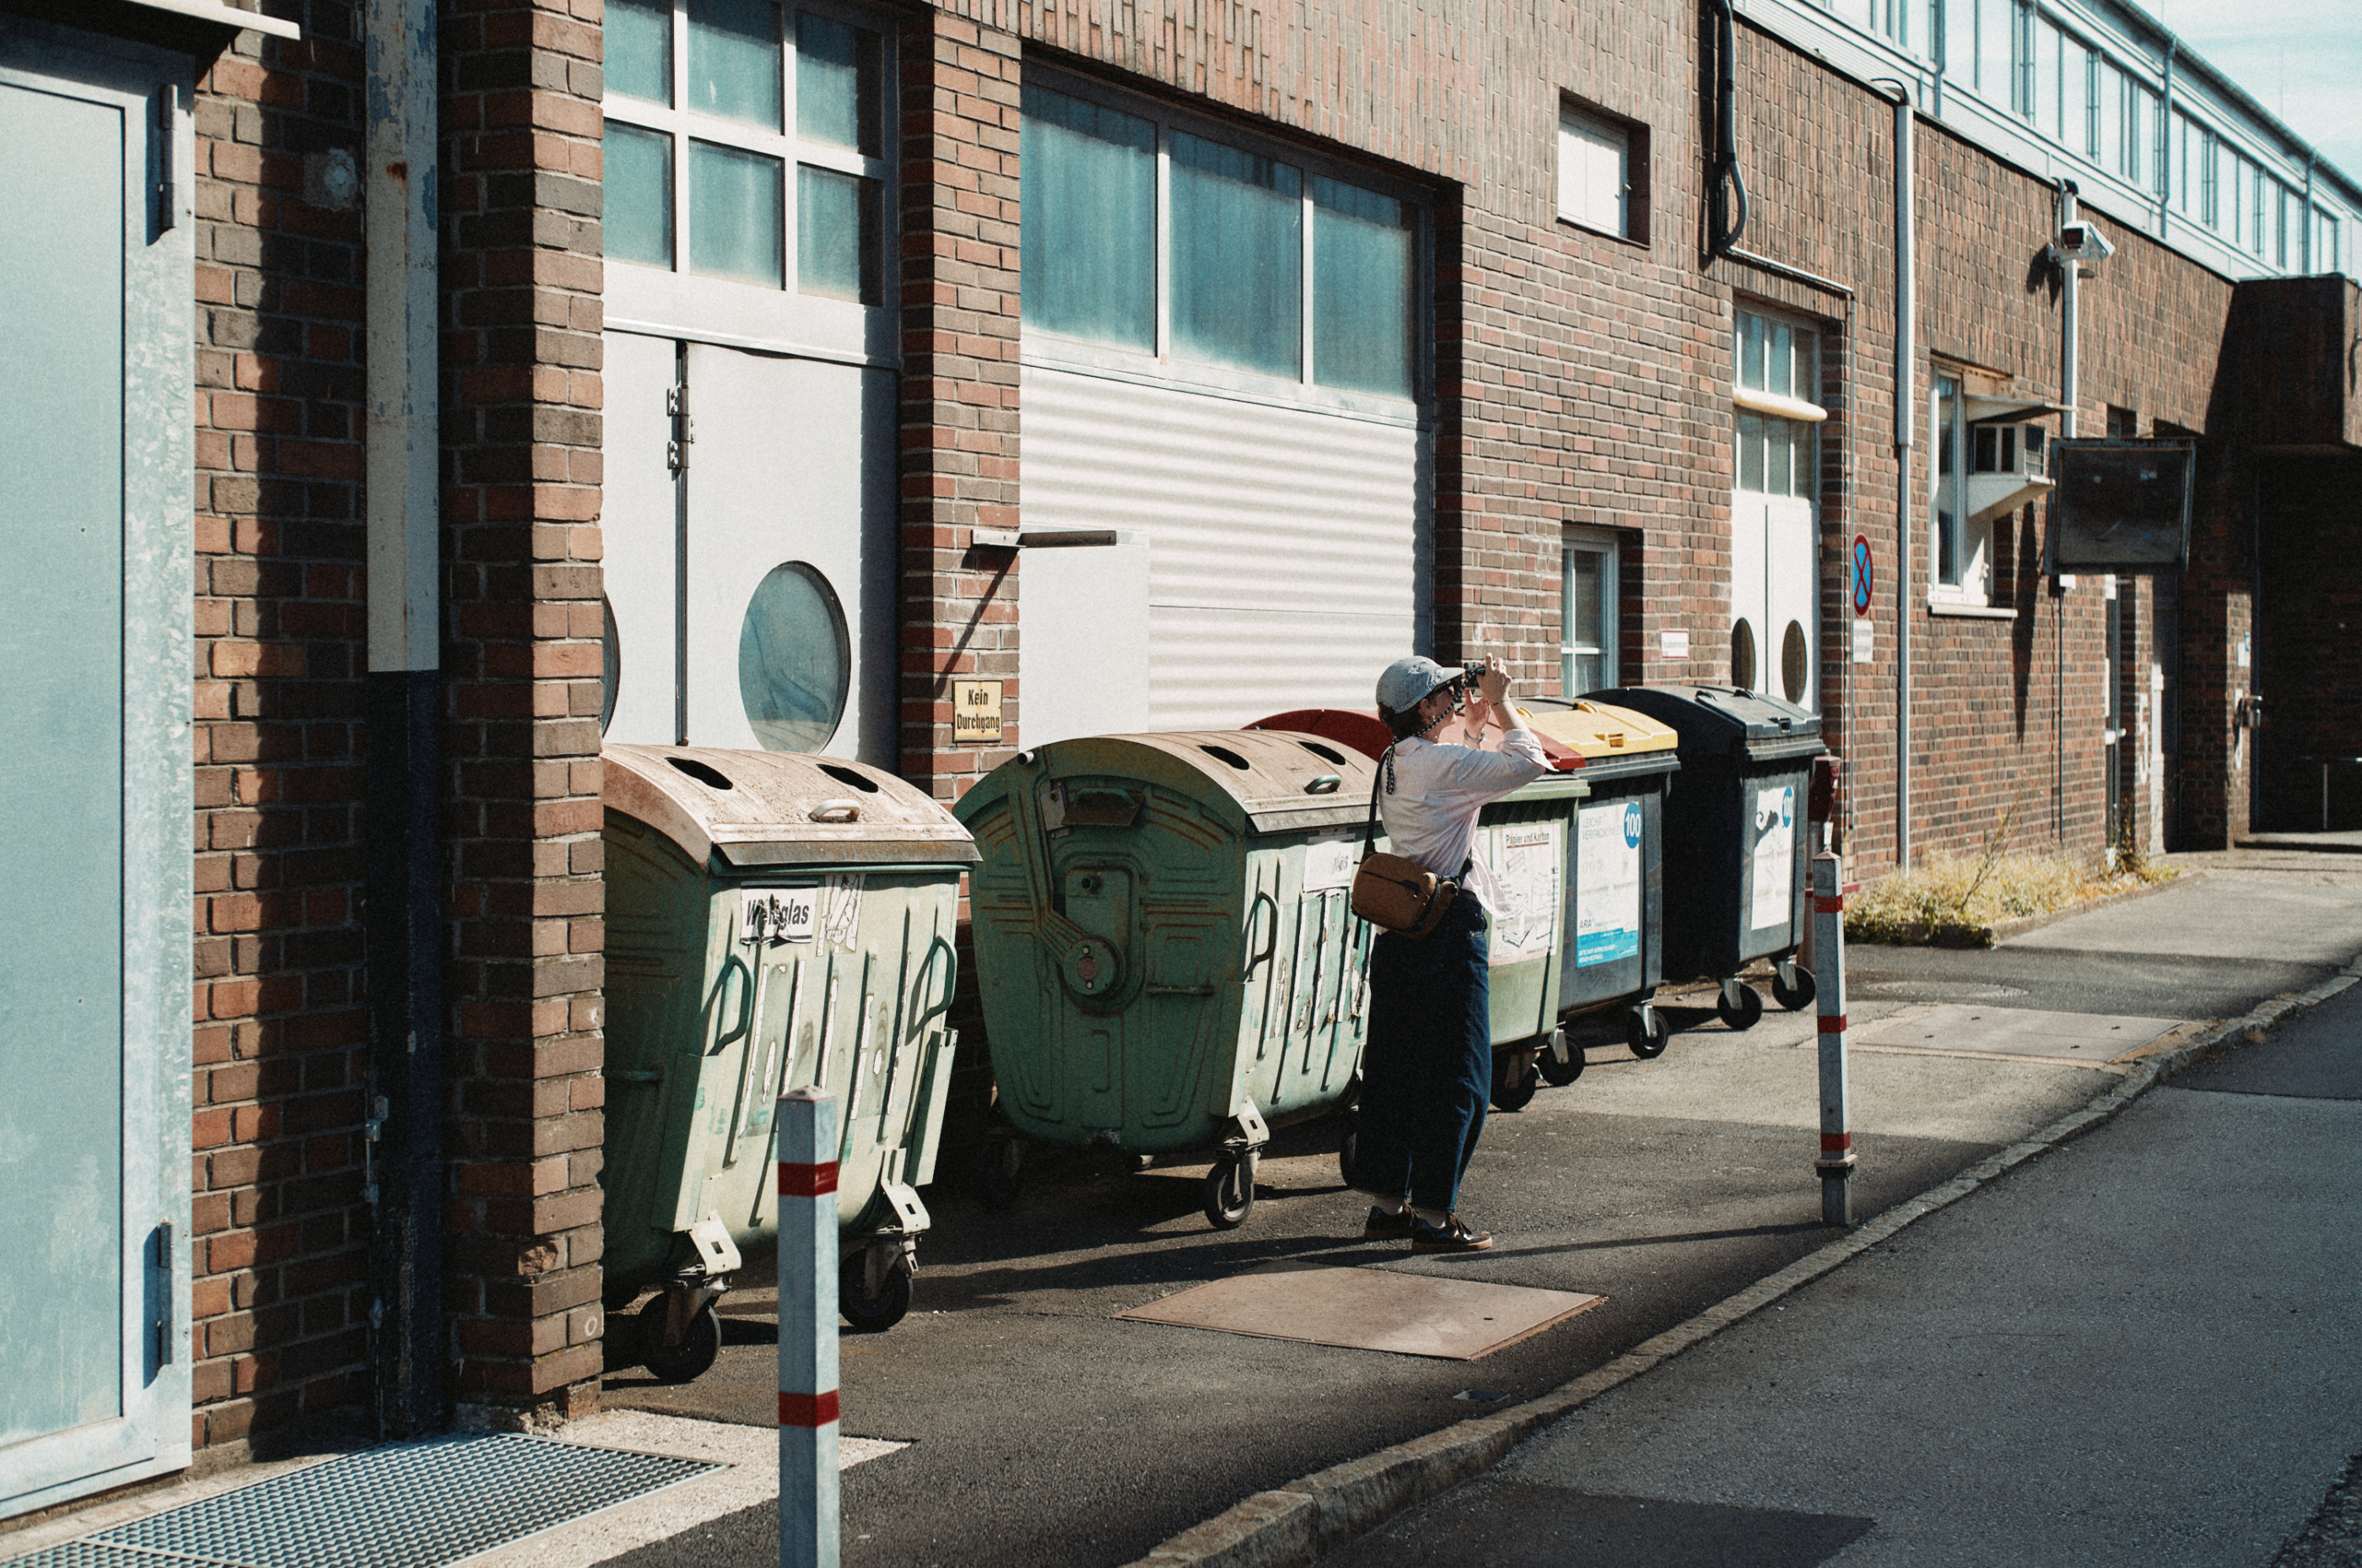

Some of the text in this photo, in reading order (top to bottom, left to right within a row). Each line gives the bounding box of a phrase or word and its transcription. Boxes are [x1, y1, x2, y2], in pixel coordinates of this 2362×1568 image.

[968, 688, 989, 705] Kein
[957, 713, 1000, 732] Durchgang
[1782, 795, 1793, 818] 100
[1625, 812, 1642, 838] 100
[1506, 832, 1550, 847] Papier und Karton
